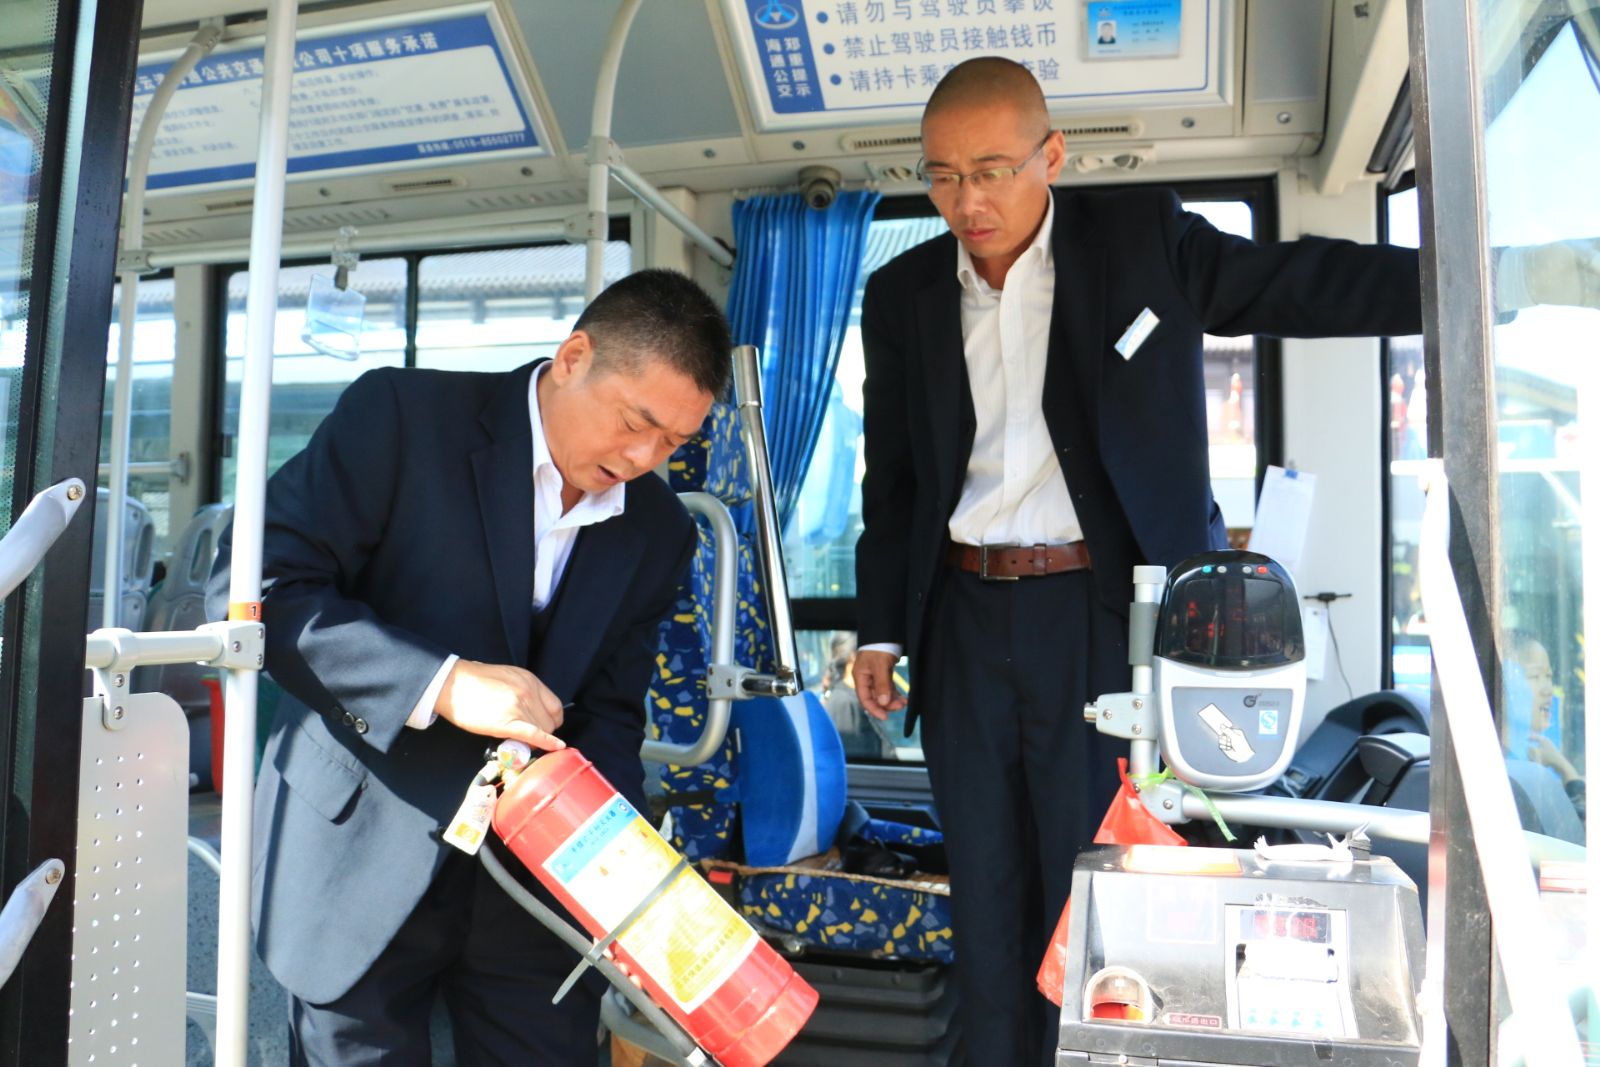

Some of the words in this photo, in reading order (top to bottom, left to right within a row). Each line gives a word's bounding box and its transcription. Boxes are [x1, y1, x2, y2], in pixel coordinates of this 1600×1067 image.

[842, 22, 1057, 59] 禁止驾驶员接触钱币
[765, 38, 793, 98] 海通公交
[784, 36, 812, 97] 郑重提示
[251, 605, 257, 617] 1
